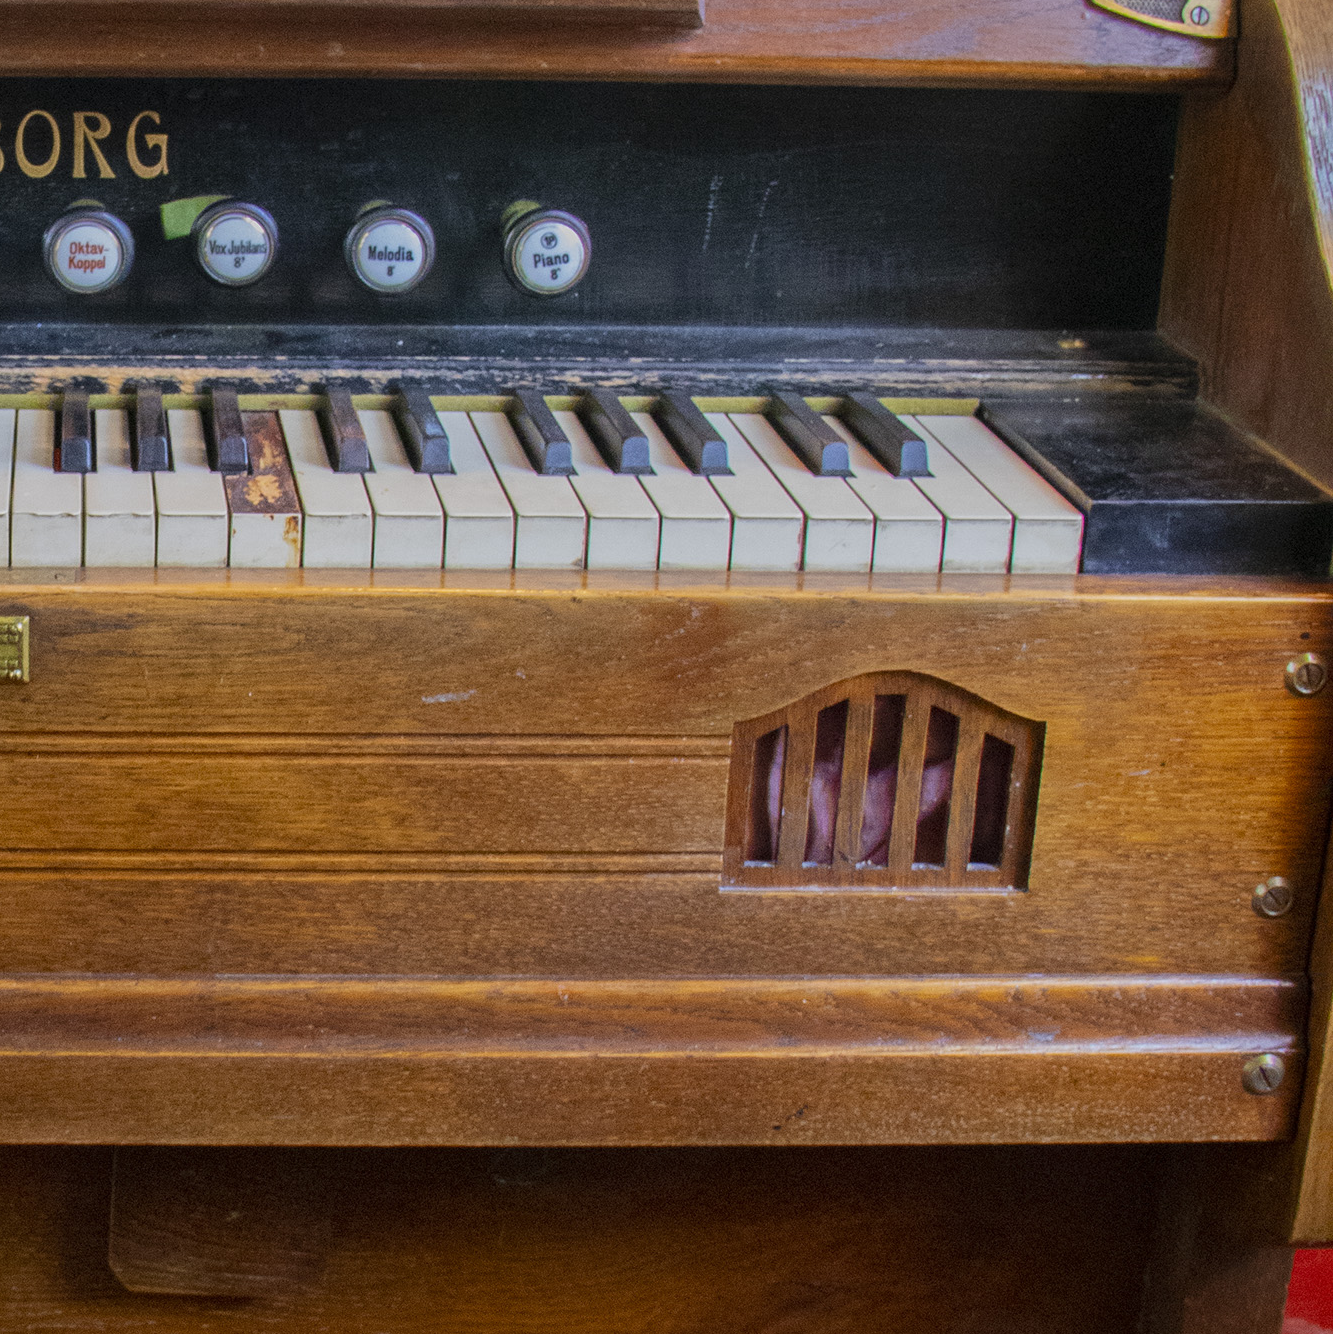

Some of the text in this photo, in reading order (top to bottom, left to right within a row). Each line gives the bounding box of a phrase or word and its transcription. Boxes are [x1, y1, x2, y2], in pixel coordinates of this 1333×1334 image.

[69, 241, 110, 255] Oktav-
[209, 240, 226, 255] Vox
[368, 245, 414, 261] Melodia
[68, 255, 106, 274] Koppel
[533, 253, 570, 269] Piano
